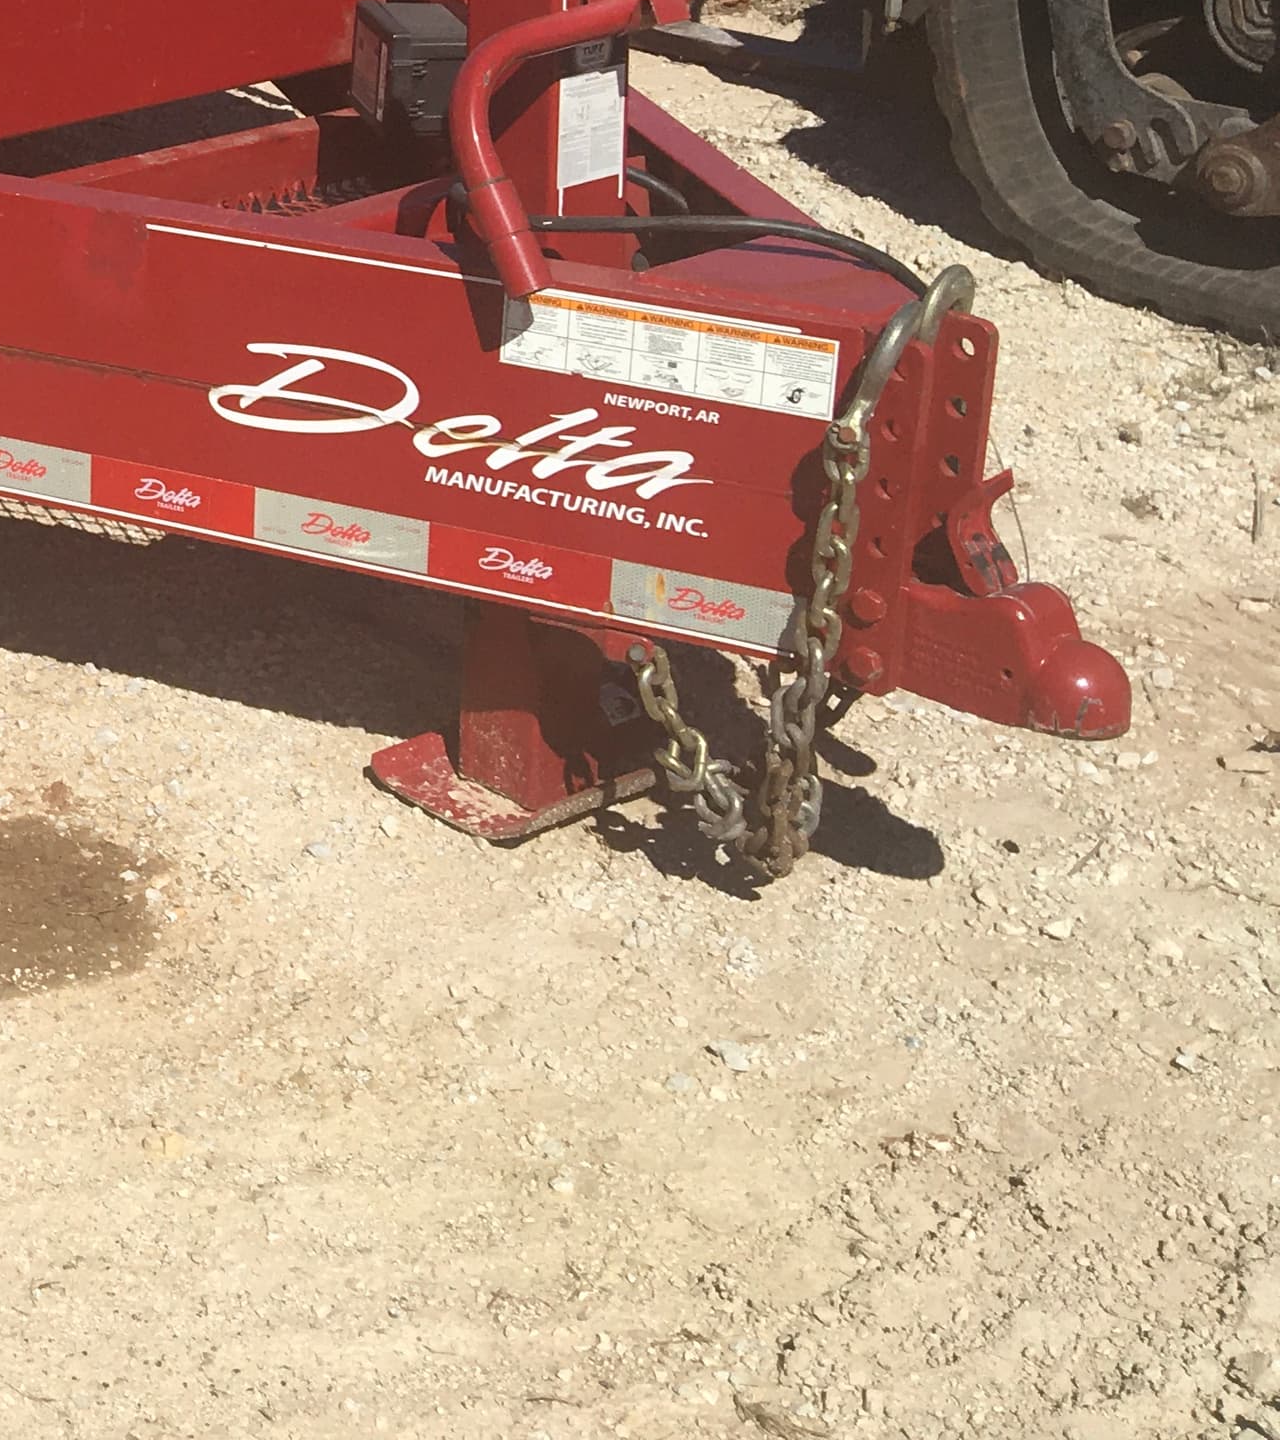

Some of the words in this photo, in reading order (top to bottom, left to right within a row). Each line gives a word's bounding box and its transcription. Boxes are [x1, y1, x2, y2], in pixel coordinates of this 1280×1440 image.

[584, 304, 629, 319] WARNING
[649, 314, 694, 329] WARNING
[715, 325, 762, 340] WARNING
[782, 338, 829, 351] WARNING
[603, 392, 693, 422] NEWPORT,
[695, 408, 721, 425] AR
[208, 342, 714, 500] Delta
[156, 500, 185, 513] TRAILERS
[423, 466, 653, 529] MANUFACTURING,
[656, 511, 710, 539] INC.
[502, 571, 534, 585] TRAILERS
